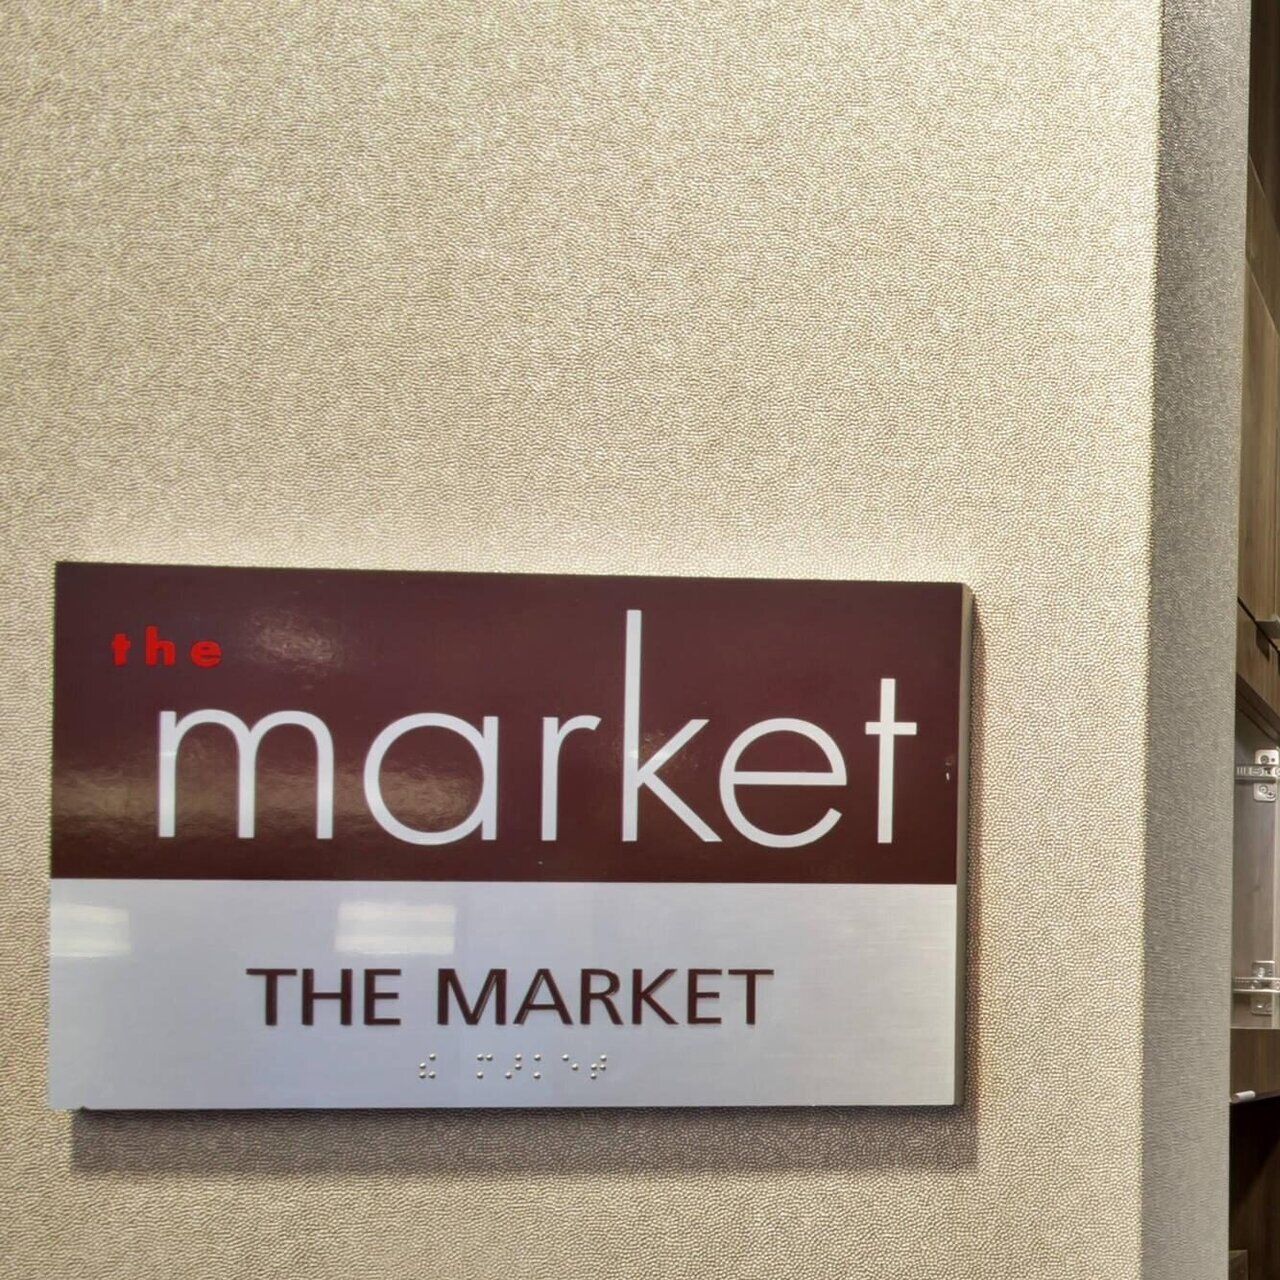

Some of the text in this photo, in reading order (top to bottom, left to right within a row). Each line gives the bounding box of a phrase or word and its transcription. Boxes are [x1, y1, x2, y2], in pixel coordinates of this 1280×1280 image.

[111, 627, 222, 668] the
[158, 609, 917, 847] market
[247, 968, 774, 1027] THE MARKET
